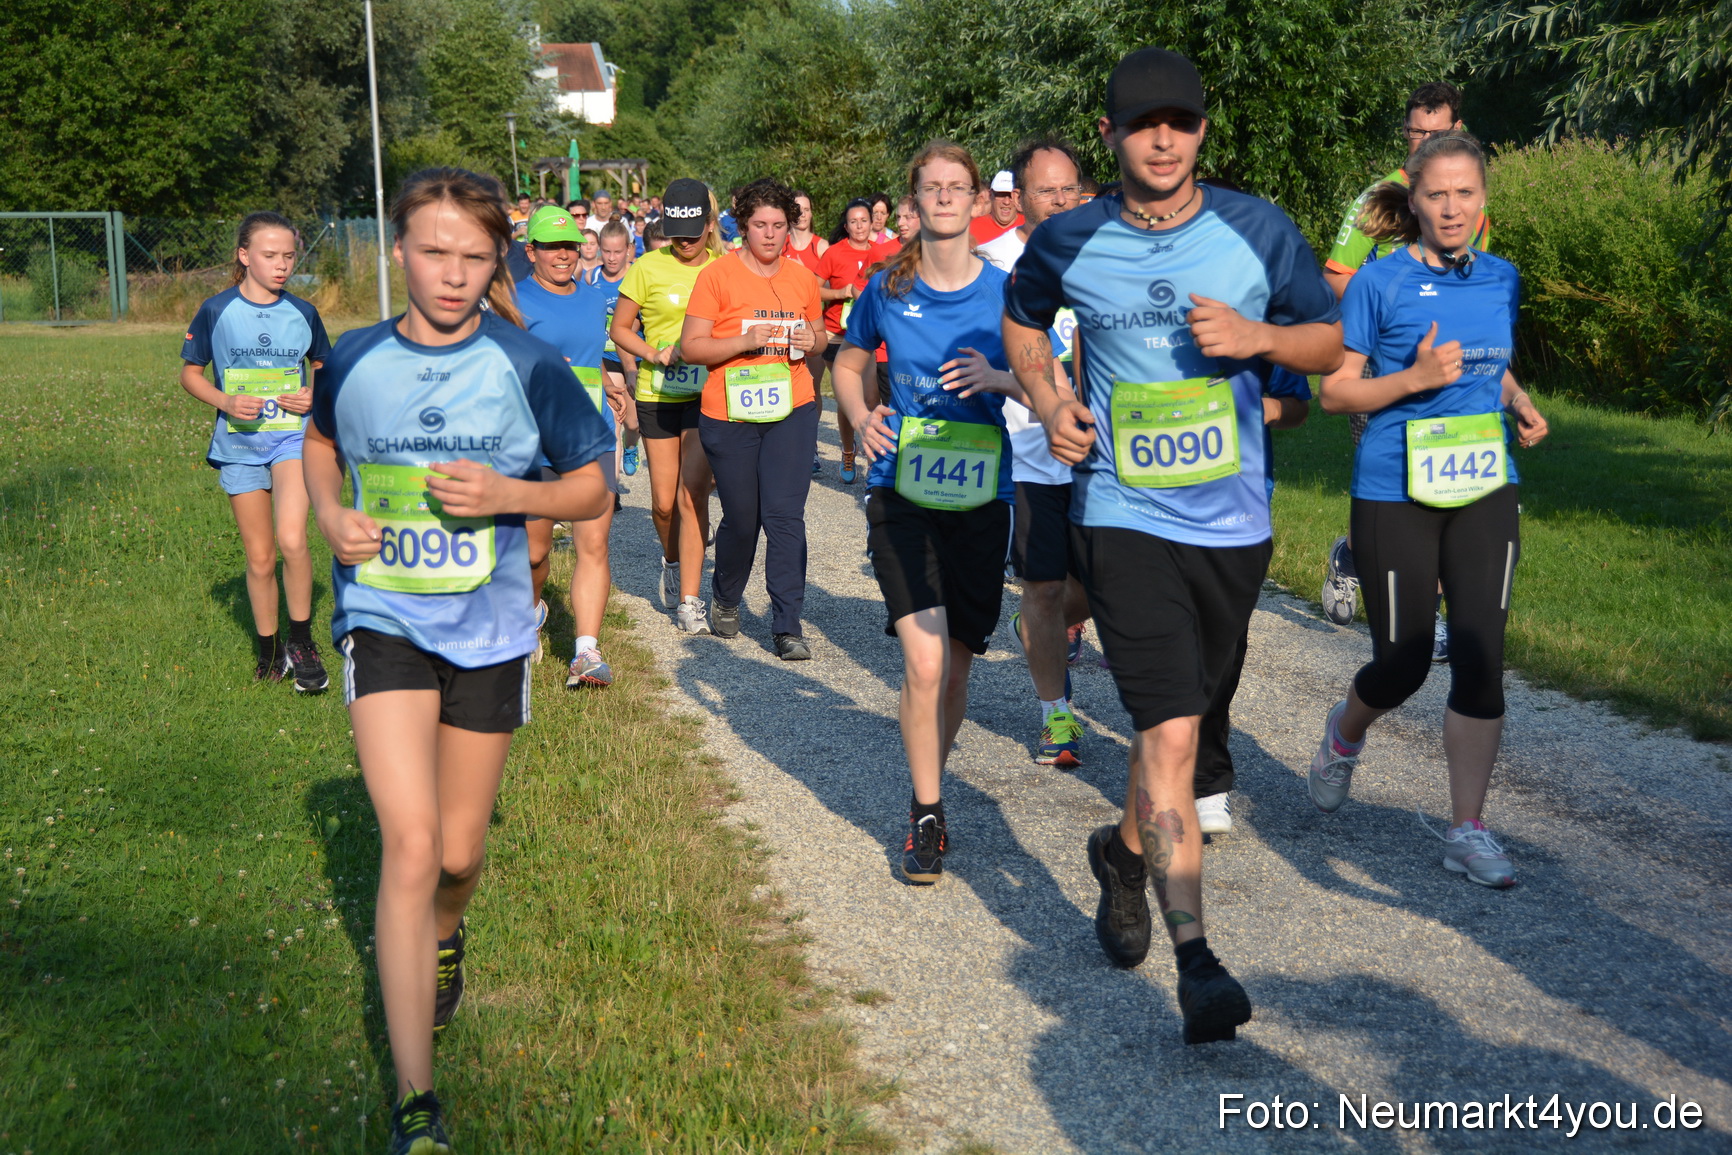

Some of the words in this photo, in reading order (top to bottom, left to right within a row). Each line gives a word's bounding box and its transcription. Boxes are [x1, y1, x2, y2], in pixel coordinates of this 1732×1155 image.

[664, 206, 702, 218] adidas
[753, 310, 768, 318] 30
[770, 310, 795, 319] Jahre
[1144, 335, 1183, 350] TEAM
[230, 348, 300, 357] SCHABMÜLLER
[1461, 347, 1485, 360] FEND
[664, 364, 700, 385] 651
[1472, 363, 1499, 376] SICH
[894, 371, 912, 385] WER
[914, 375, 943, 389] LAUF
[740, 387, 780, 408] 615
[912, 392, 950, 407] BEWEGT
[952, 395, 977, 408] SICH
[1116, 390, 1148, 402] 2013
[368, 435, 502, 453] SCHABMÜLLER
[1130, 425, 1223, 468] 6090
[909, 454, 985, 488] 1441
[1420, 450, 1497, 483] 1442
[366, 474, 395, 487] 2013
[379, 526, 478, 569] 6096
